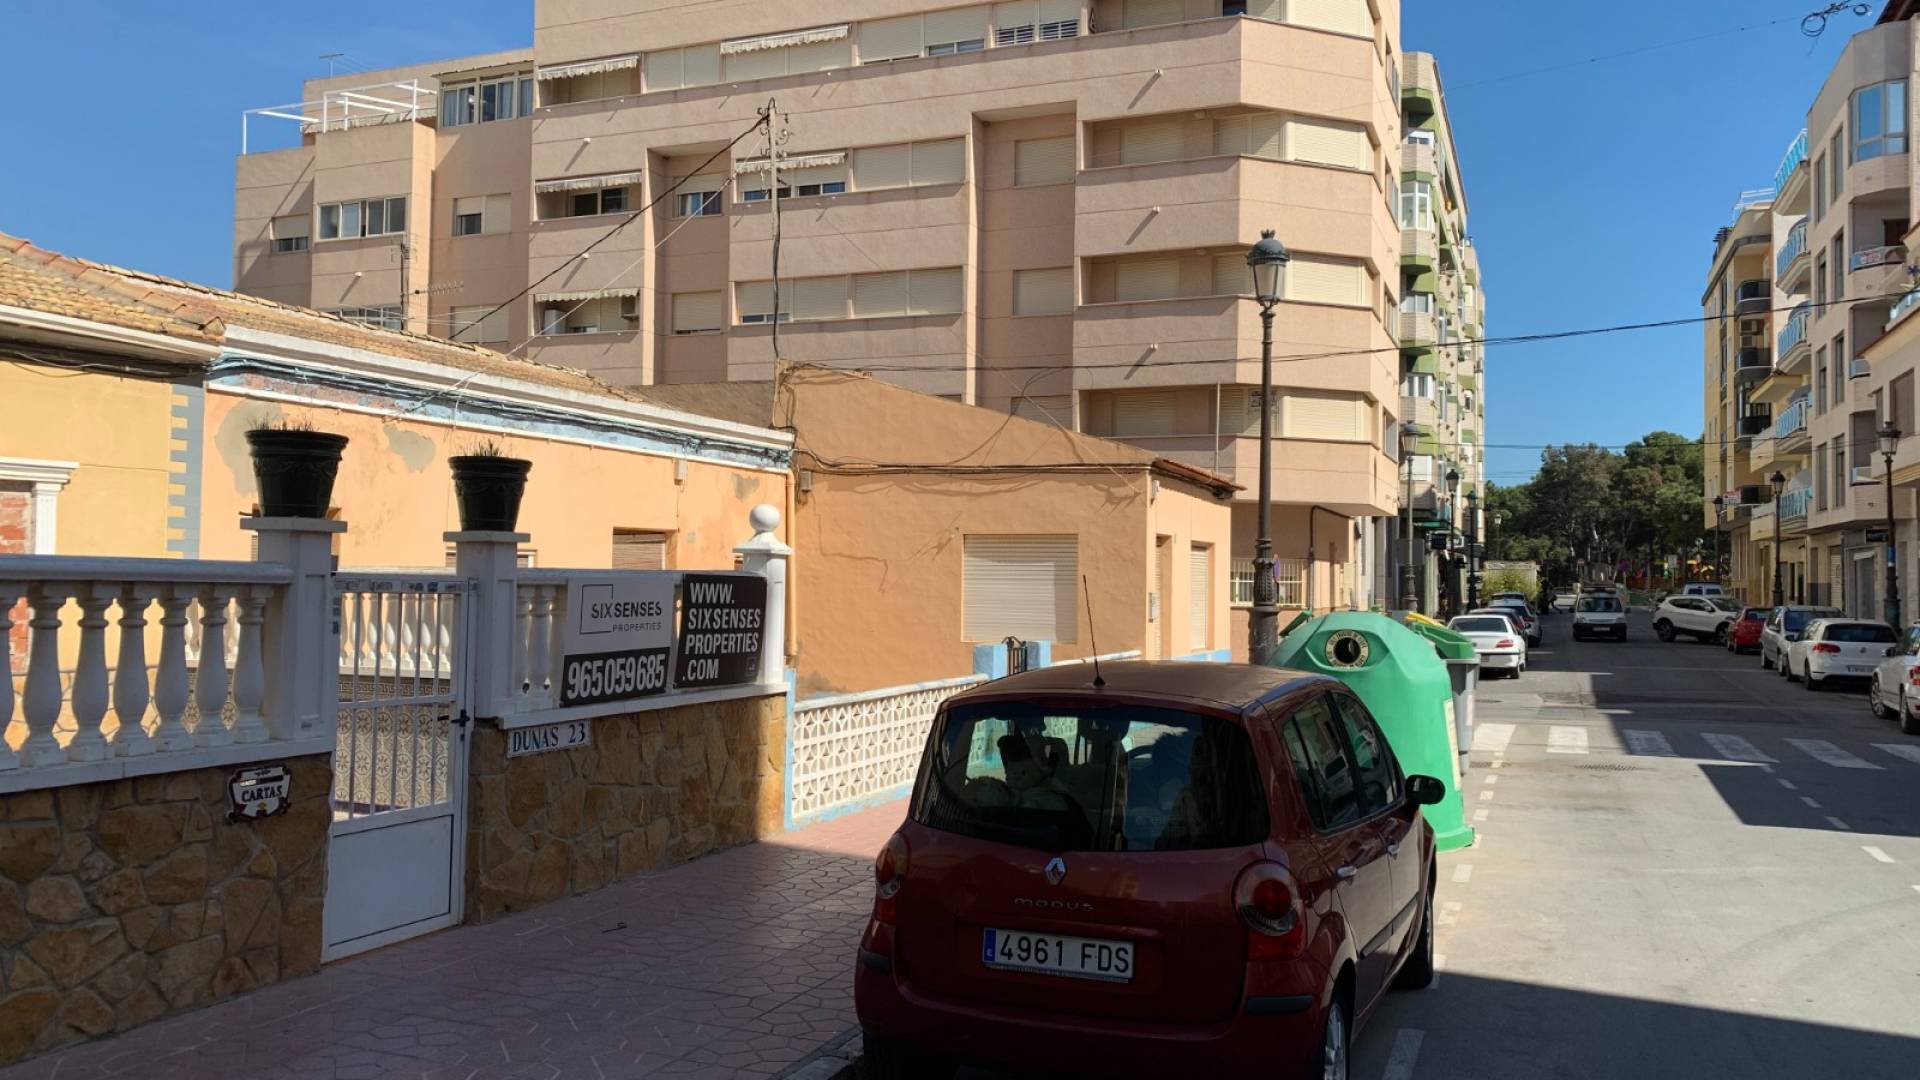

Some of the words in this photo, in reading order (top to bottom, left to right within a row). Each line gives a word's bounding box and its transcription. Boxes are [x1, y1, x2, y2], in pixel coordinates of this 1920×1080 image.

[689, 582, 735, 604] WWW.
[612, 622, 662, 633] PROPERTIES
[685, 632, 759, 655] PROPERTIES
[682, 658, 719, 680] .COM
[513, 726, 559, 752] DUNAS
[568, 722, 586, 744] 23
[241, 785, 283, 803] CARTAS
[1000, 934, 1064, 967] 4961
[1080, 942, 1129, 973] FDS
